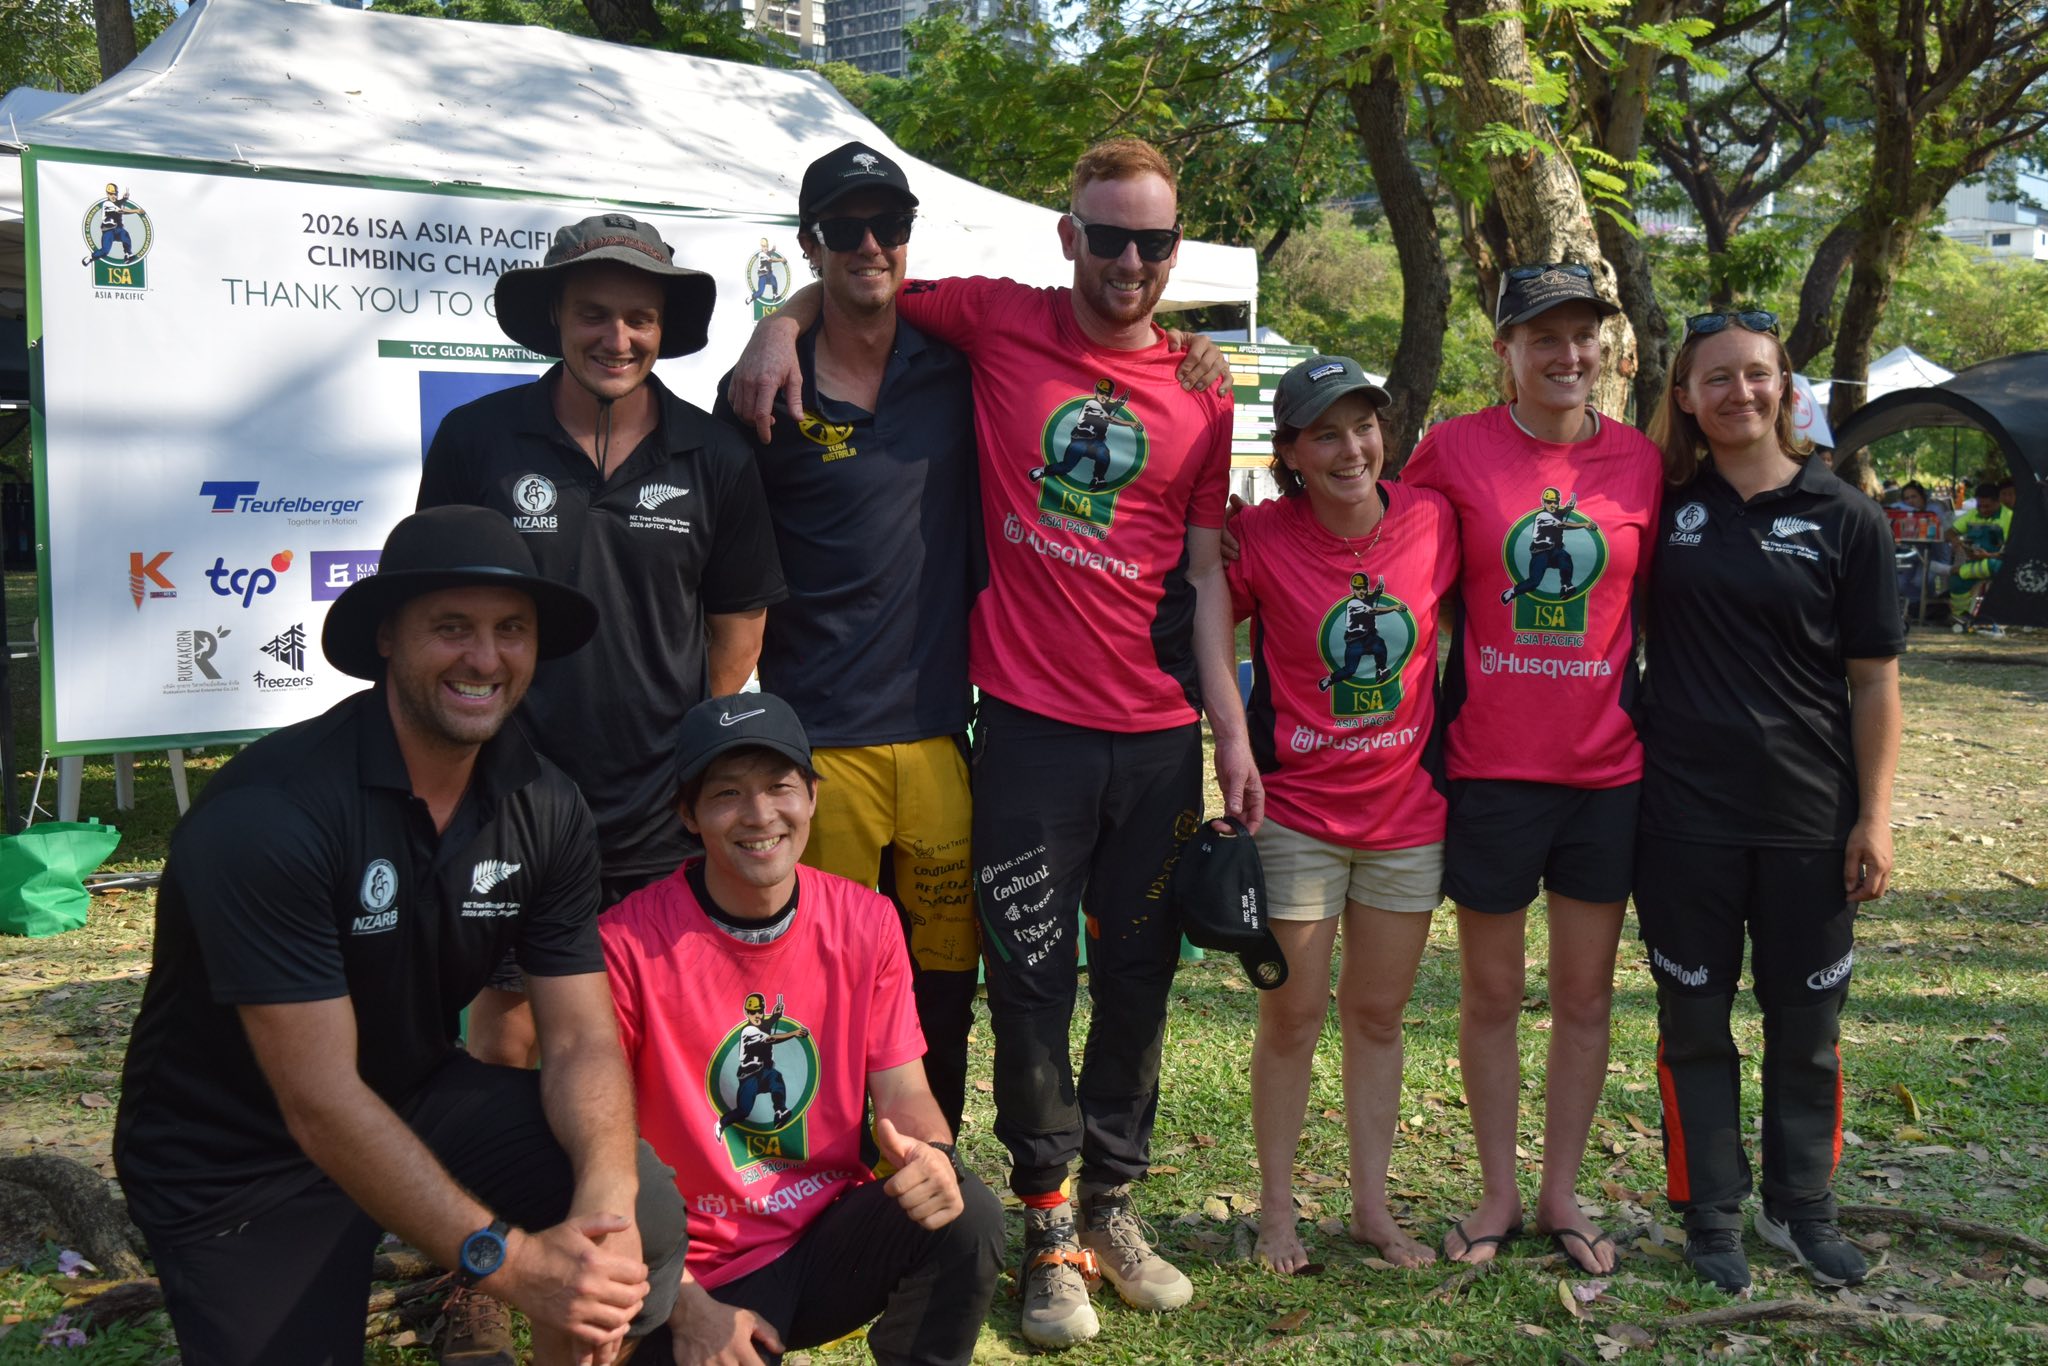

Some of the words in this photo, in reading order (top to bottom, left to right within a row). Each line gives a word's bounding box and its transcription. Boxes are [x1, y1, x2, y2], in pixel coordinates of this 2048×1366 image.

[302, 213, 359, 236] 2026
[368, 218, 407, 241] ISA
[415, 222, 472, 246] ASIA
[480, 227, 552, 251] PACIFI
[307, 245, 435, 273] CLIMBING
[444, 255, 540, 277] CHAM
[107, 267, 132, 285] ISA
[95, 291, 112, 299] ASIA
[115, 292, 145, 301] PACIFIC
[221, 278, 341, 311] THANK
[351, 285, 418, 314] YOU
[430, 290, 473, 316] TO
[410, 344, 436, 356] TCC
[439, 345, 489, 358] GLOBAL
[239, 497, 364, 515] Teufelberger
[1060, 490, 1092, 517] ISA
[287, 518, 321, 528] Together
[513, 516, 558, 528] NZARB
[1038, 514, 1062, 530] ASIA
[1065, 520, 1108, 541] PACIFIC
[357, 563, 379, 573] KIAT
[205, 557, 277, 609] tcp
[1533, 605, 1566, 628] ISA
[1515, 634, 1539, 645] ASIA
[1542, 634, 1584, 647] PACIFIC
[176, 630, 193, 682] RUKKAKORN
[1353, 689, 1384, 712] ISA
[1334, 719, 1359, 728] ASIA
[1248, 887, 1257, 914] ZEALAND
[352, 911, 399, 930] NZARB
[1251, 916, 1259, 930] NEW
[744, 1135, 783, 1158] ISA
[741, 1169, 761, 1186] ASIA
